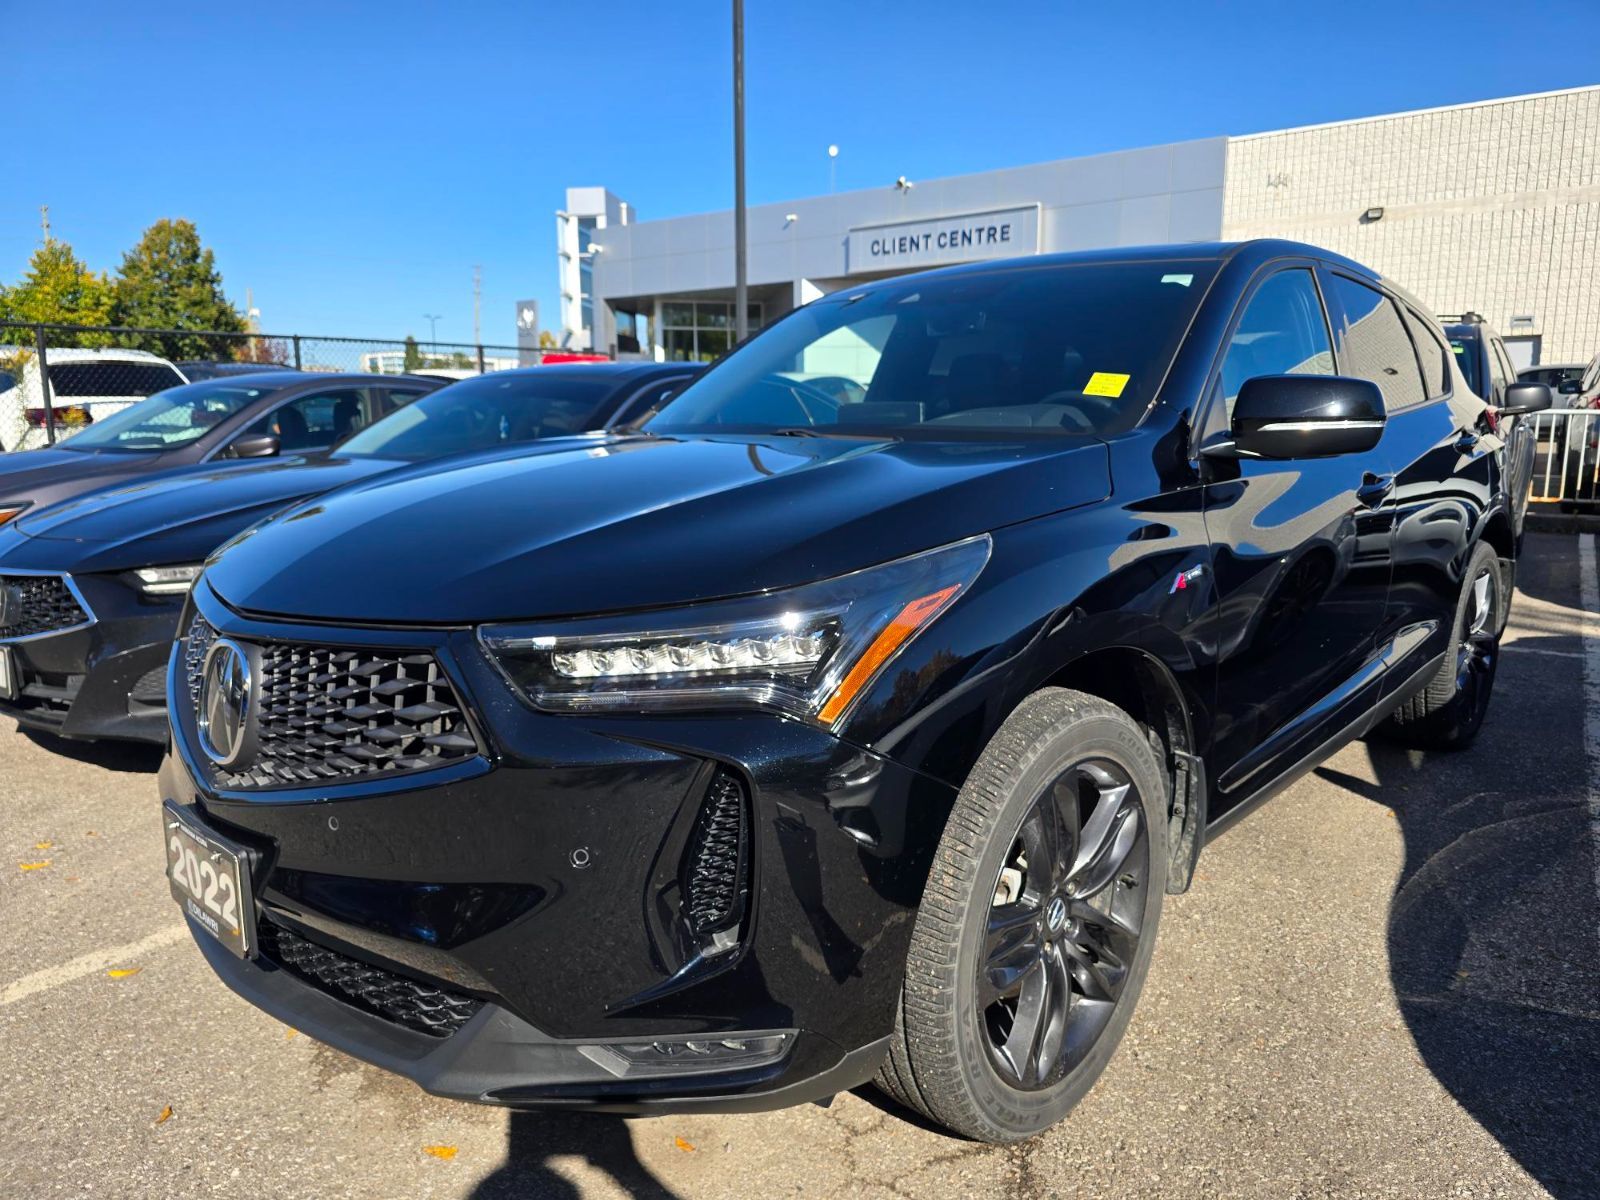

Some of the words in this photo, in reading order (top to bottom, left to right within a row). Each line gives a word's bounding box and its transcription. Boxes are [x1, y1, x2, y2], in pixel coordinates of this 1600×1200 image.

[871, 233, 932, 256] CLIENT
[937, 224, 1011, 249] CENTRE
[170, 835, 239, 930] 2022
